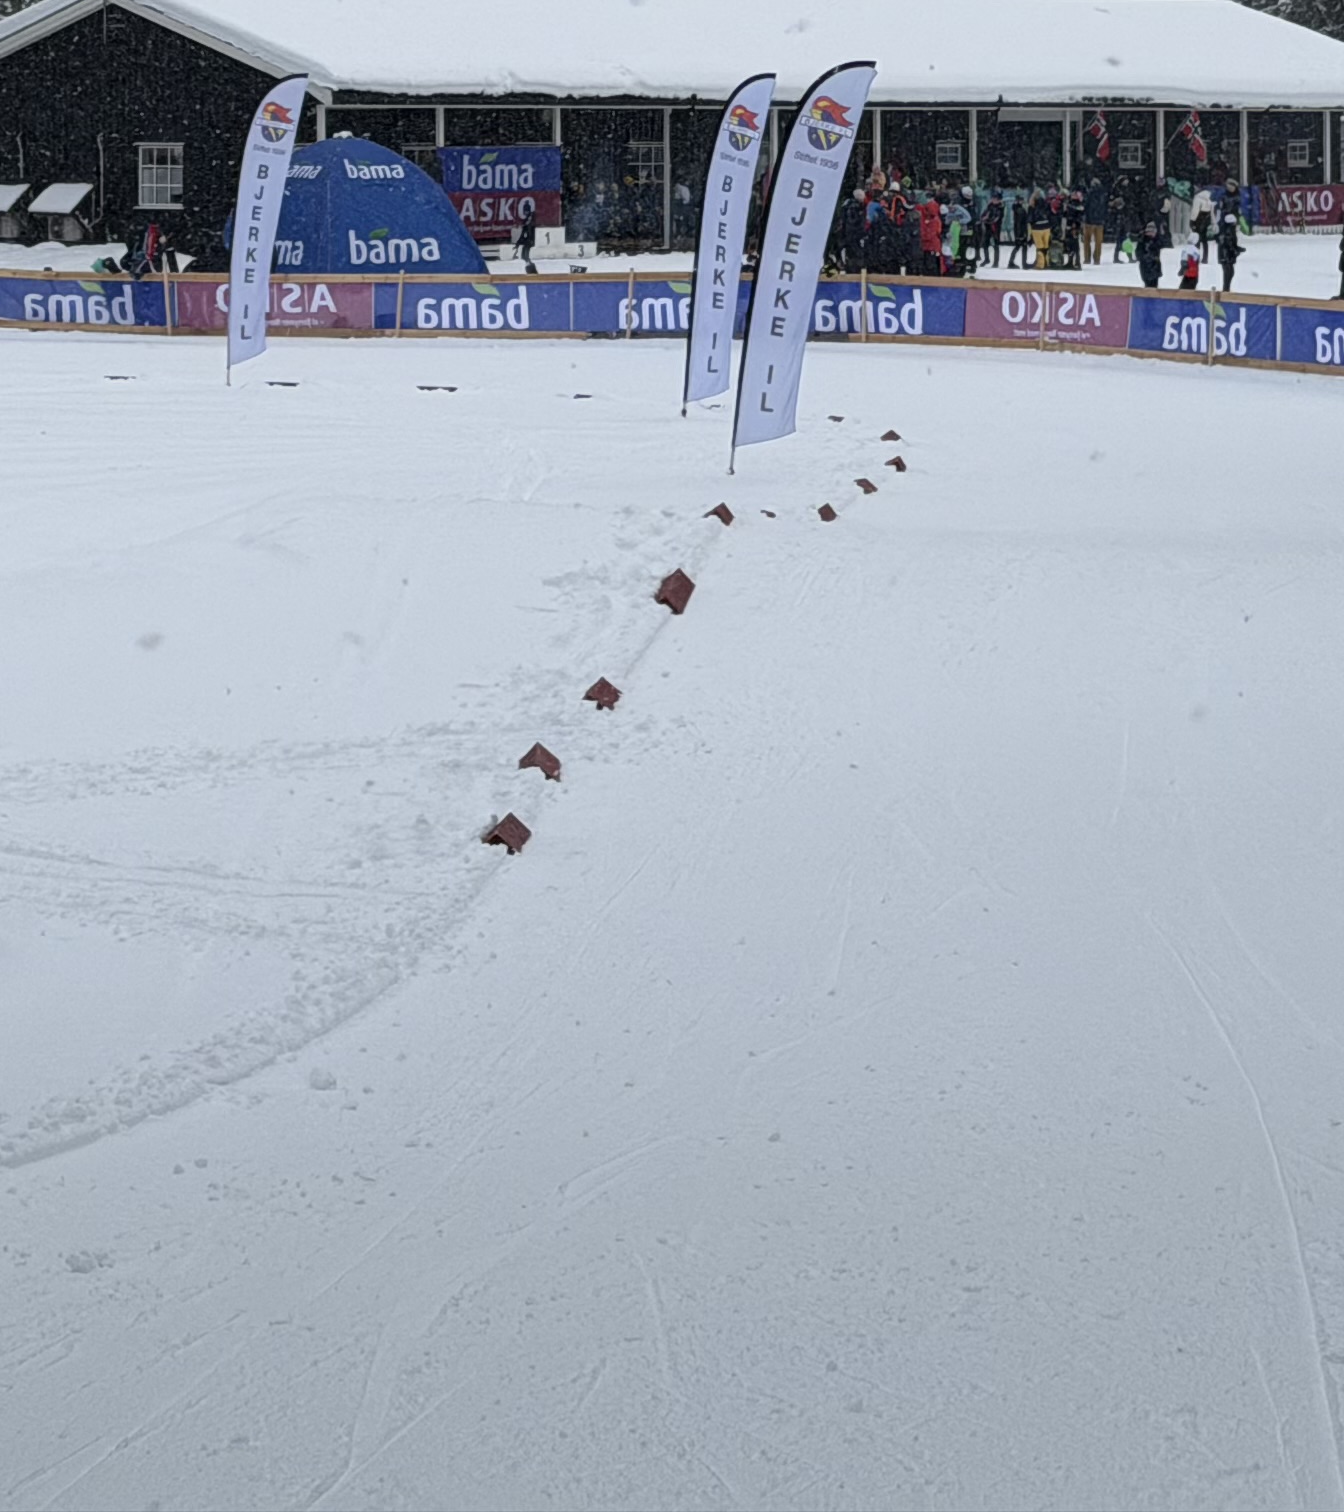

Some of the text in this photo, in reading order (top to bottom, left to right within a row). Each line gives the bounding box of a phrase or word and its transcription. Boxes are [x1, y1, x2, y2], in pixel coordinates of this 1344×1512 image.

[287, 165, 323, 180] ama
[344, 158, 405, 180] bama
[462, 154, 534, 190] bama
[460, 196, 536, 222] ASKO
[1278, 190, 1333, 213] ASKO
[244, 164, 269, 284] BJERKE
[348, 229, 441, 265] bama
[545, 231, 551, 245] 1
[712, 175, 734, 310] BJERKE
[274, 240, 304, 265] ma
[577, 244, 585, 258] 3
[770, 177, 815, 337] BJERKE
